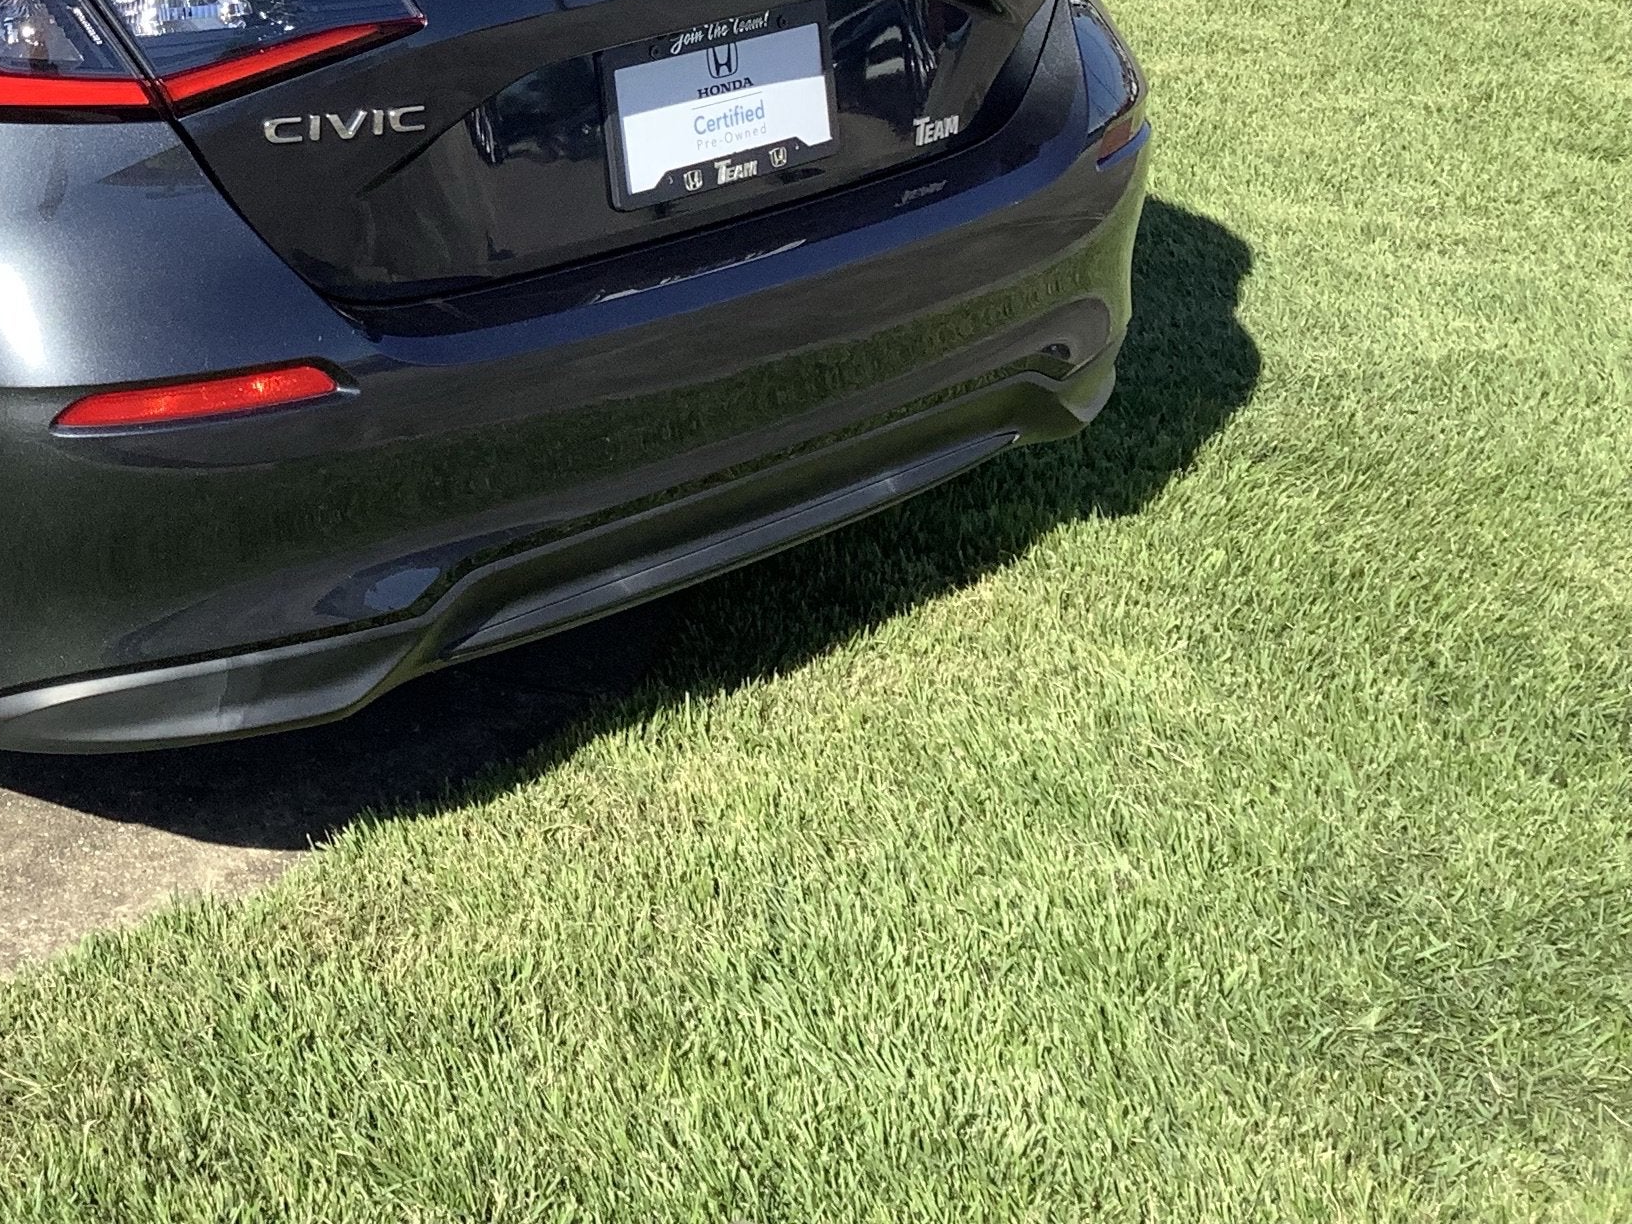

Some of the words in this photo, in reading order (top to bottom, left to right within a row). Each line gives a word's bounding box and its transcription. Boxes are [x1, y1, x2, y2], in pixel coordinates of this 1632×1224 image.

[670, 27, 704, 55] Join
[697, 77, 754, 99] HONDA
[264, 105, 426, 144] CIVIC
[694, 100, 766, 135] Certified
[913, 115, 960, 146] TEAM
[697, 125, 767, 151] Pre-Owned
[714, 159, 758, 185] TEAM
